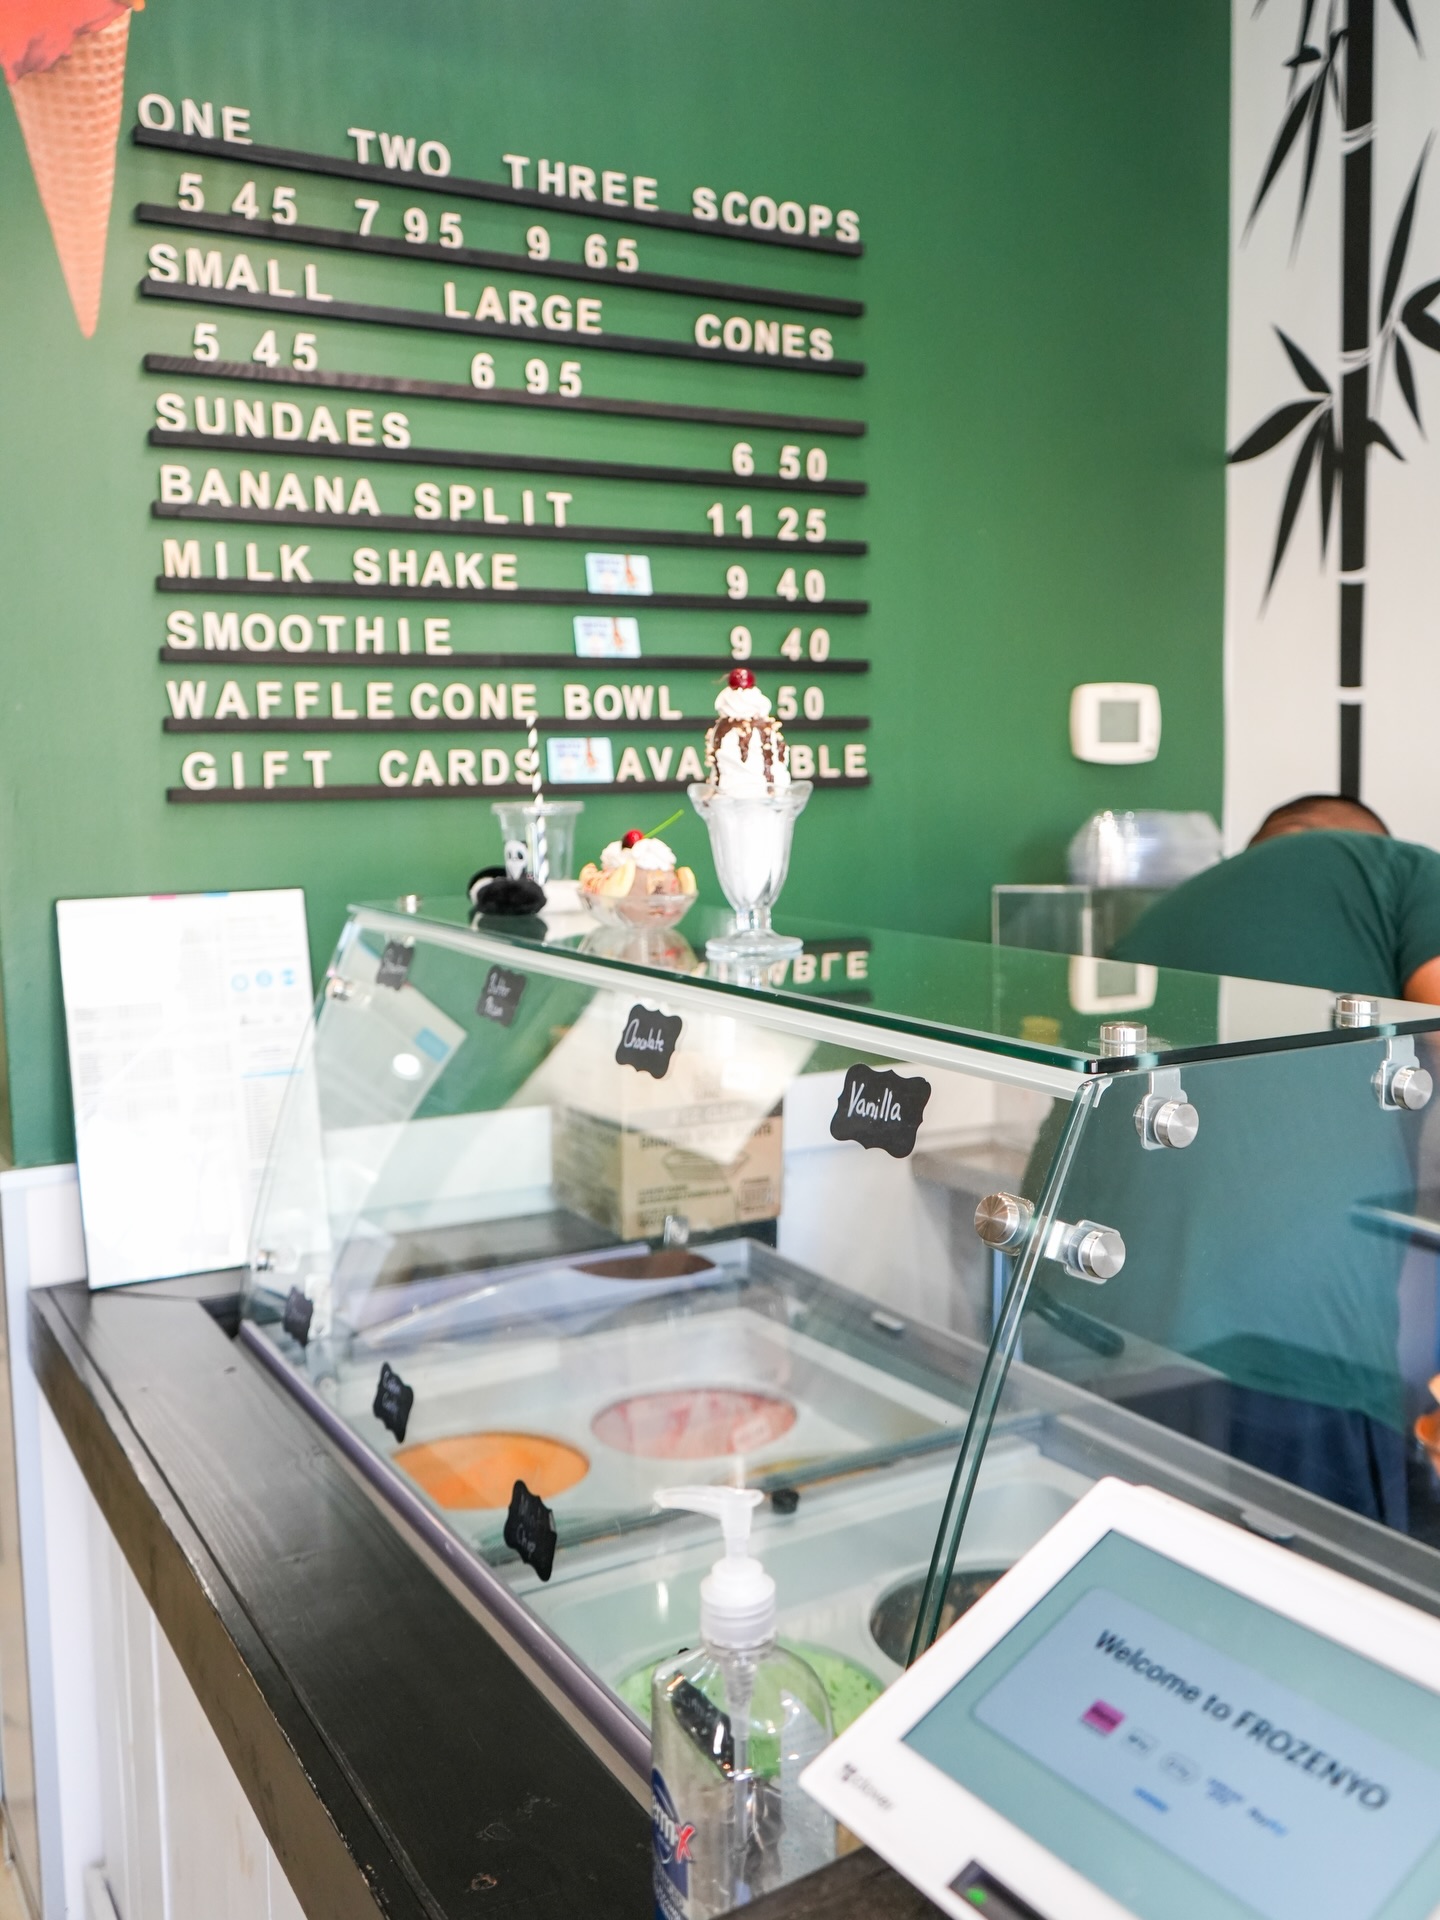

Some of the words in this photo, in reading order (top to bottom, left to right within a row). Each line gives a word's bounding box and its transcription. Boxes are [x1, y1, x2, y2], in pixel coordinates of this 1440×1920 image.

[138, 93, 254, 146] ONE
[347, 127, 452, 178] TWO
[502, 153, 660, 213] THREE
[692, 186, 860, 244] SCOOPS
[178, 171, 206, 213] 5
[231, 180, 299, 227] 45
[354, 198, 380, 236] 7
[403, 207, 464, 249] 95
[526, 225, 552, 261] 9
[584, 233, 640, 273] 65
[147, 241, 336, 304] SMALL
[443, 281, 604, 336] LARGE
[695, 312, 834, 362] CONES
[192, 322, 219, 363] 5
[252, 328, 320, 373] 45
[471, 352, 496, 390] 6
[525, 358, 584, 399] 95
[155, 389, 413, 449] SUNDAES
[732, 442, 755, 477] 6
[779, 445, 829, 482] 50
[159, 463, 382, 518] BANANA
[413, 482, 574, 529] SPLIT
[706, 502, 754, 539] 11
[777, 506, 828, 543] 25
[162, 537, 315, 584] MILK
[352, 547, 520, 592] SHAKE
[726, 564, 749, 600] 9
[776, 567, 827, 603] 40
[166, 609, 455, 657] SMOOTHIE
[730, 625, 752, 660] 9
[780, 627, 831, 663] 40
[165, 679, 396, 721] WAFFLE
[410, 682, 539, 721] CONE
[562, 683, 684, 722] BOWL
[776, 685, 826, 721] 50
[181, 749, 334, 791] GIFT
[378, 748, 537, 788] CARDS
[616, 743, 869, 784] AVABLE
[624, 1018, 665, 1052] Chocolate
[847, 1080, 902, 1121] Vanilla
[1095, 1629, 1202, 1704] Welcome
[1201, 1693, 1233, 1722] to
[1231, 1710, 1392, 1812] FROZENYO
